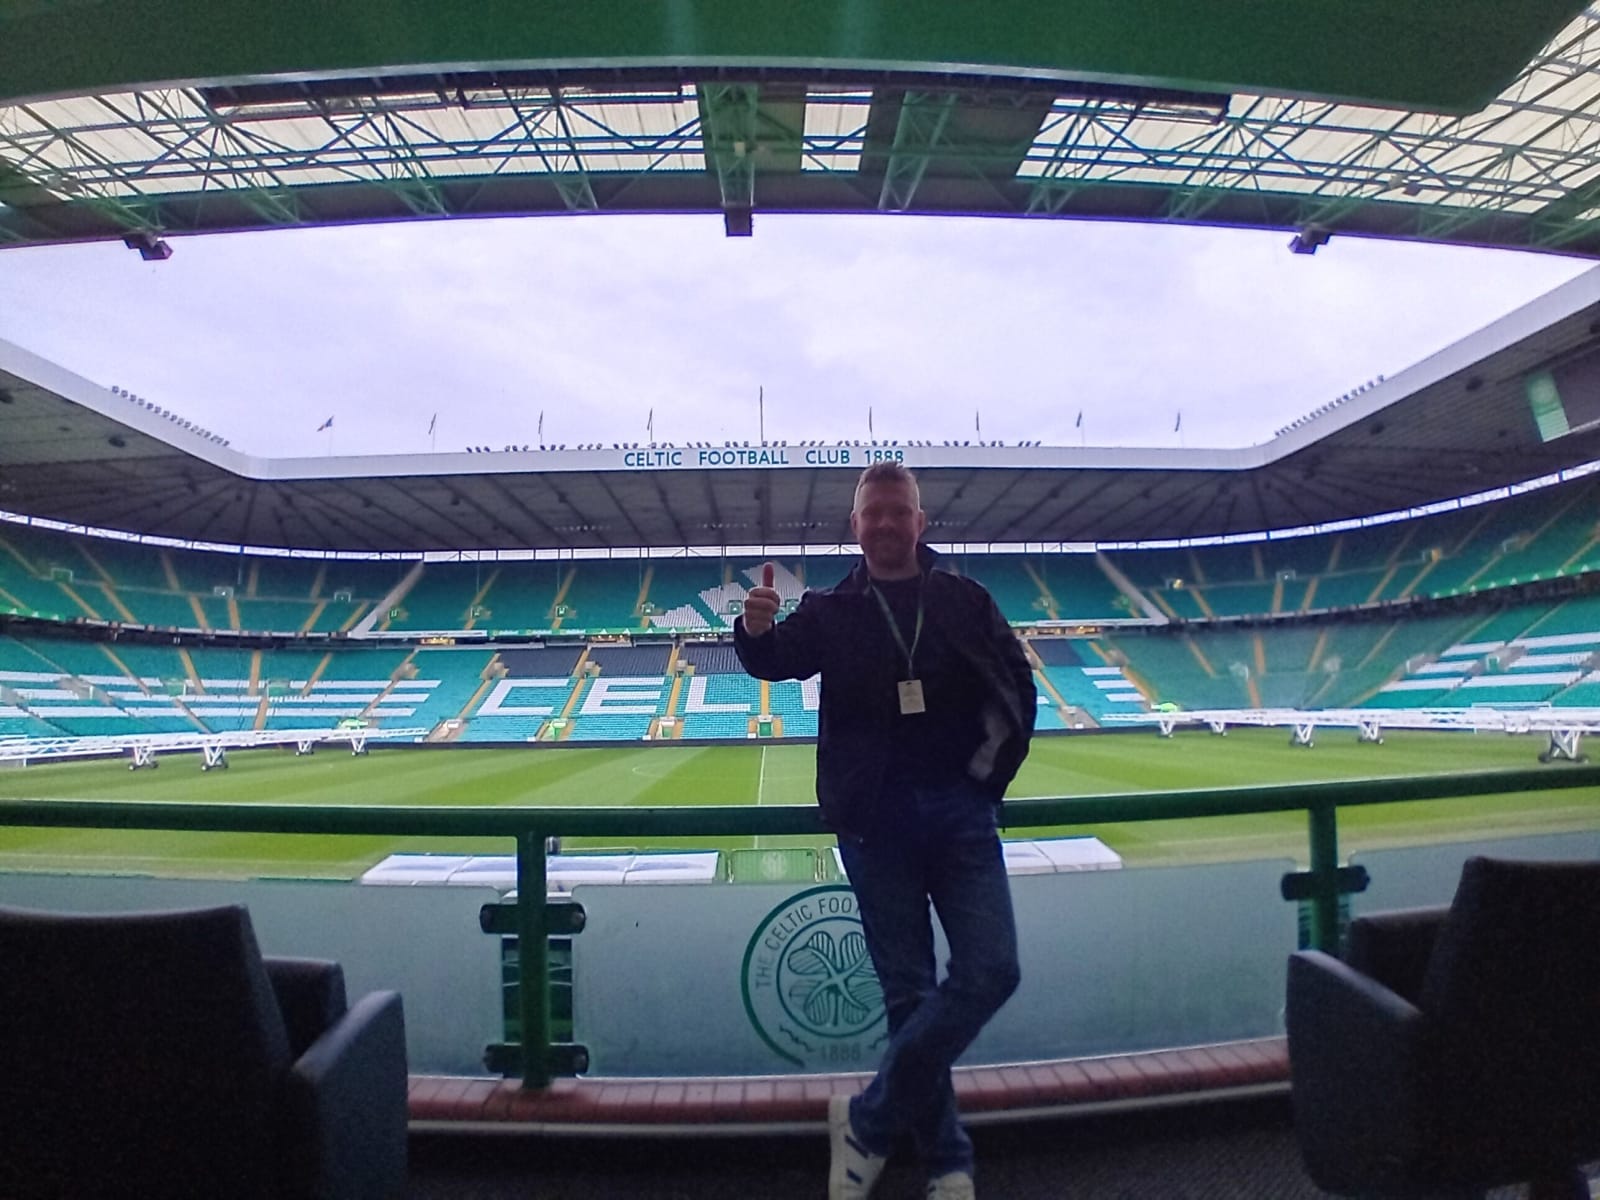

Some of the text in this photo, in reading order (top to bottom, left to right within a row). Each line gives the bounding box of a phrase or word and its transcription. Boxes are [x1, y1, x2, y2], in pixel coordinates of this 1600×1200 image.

[624, 449, 904, 467] CELTIC FOOTBALL CLUB 1888
[755, 897, 860, 989] THE CELTIC FOO
